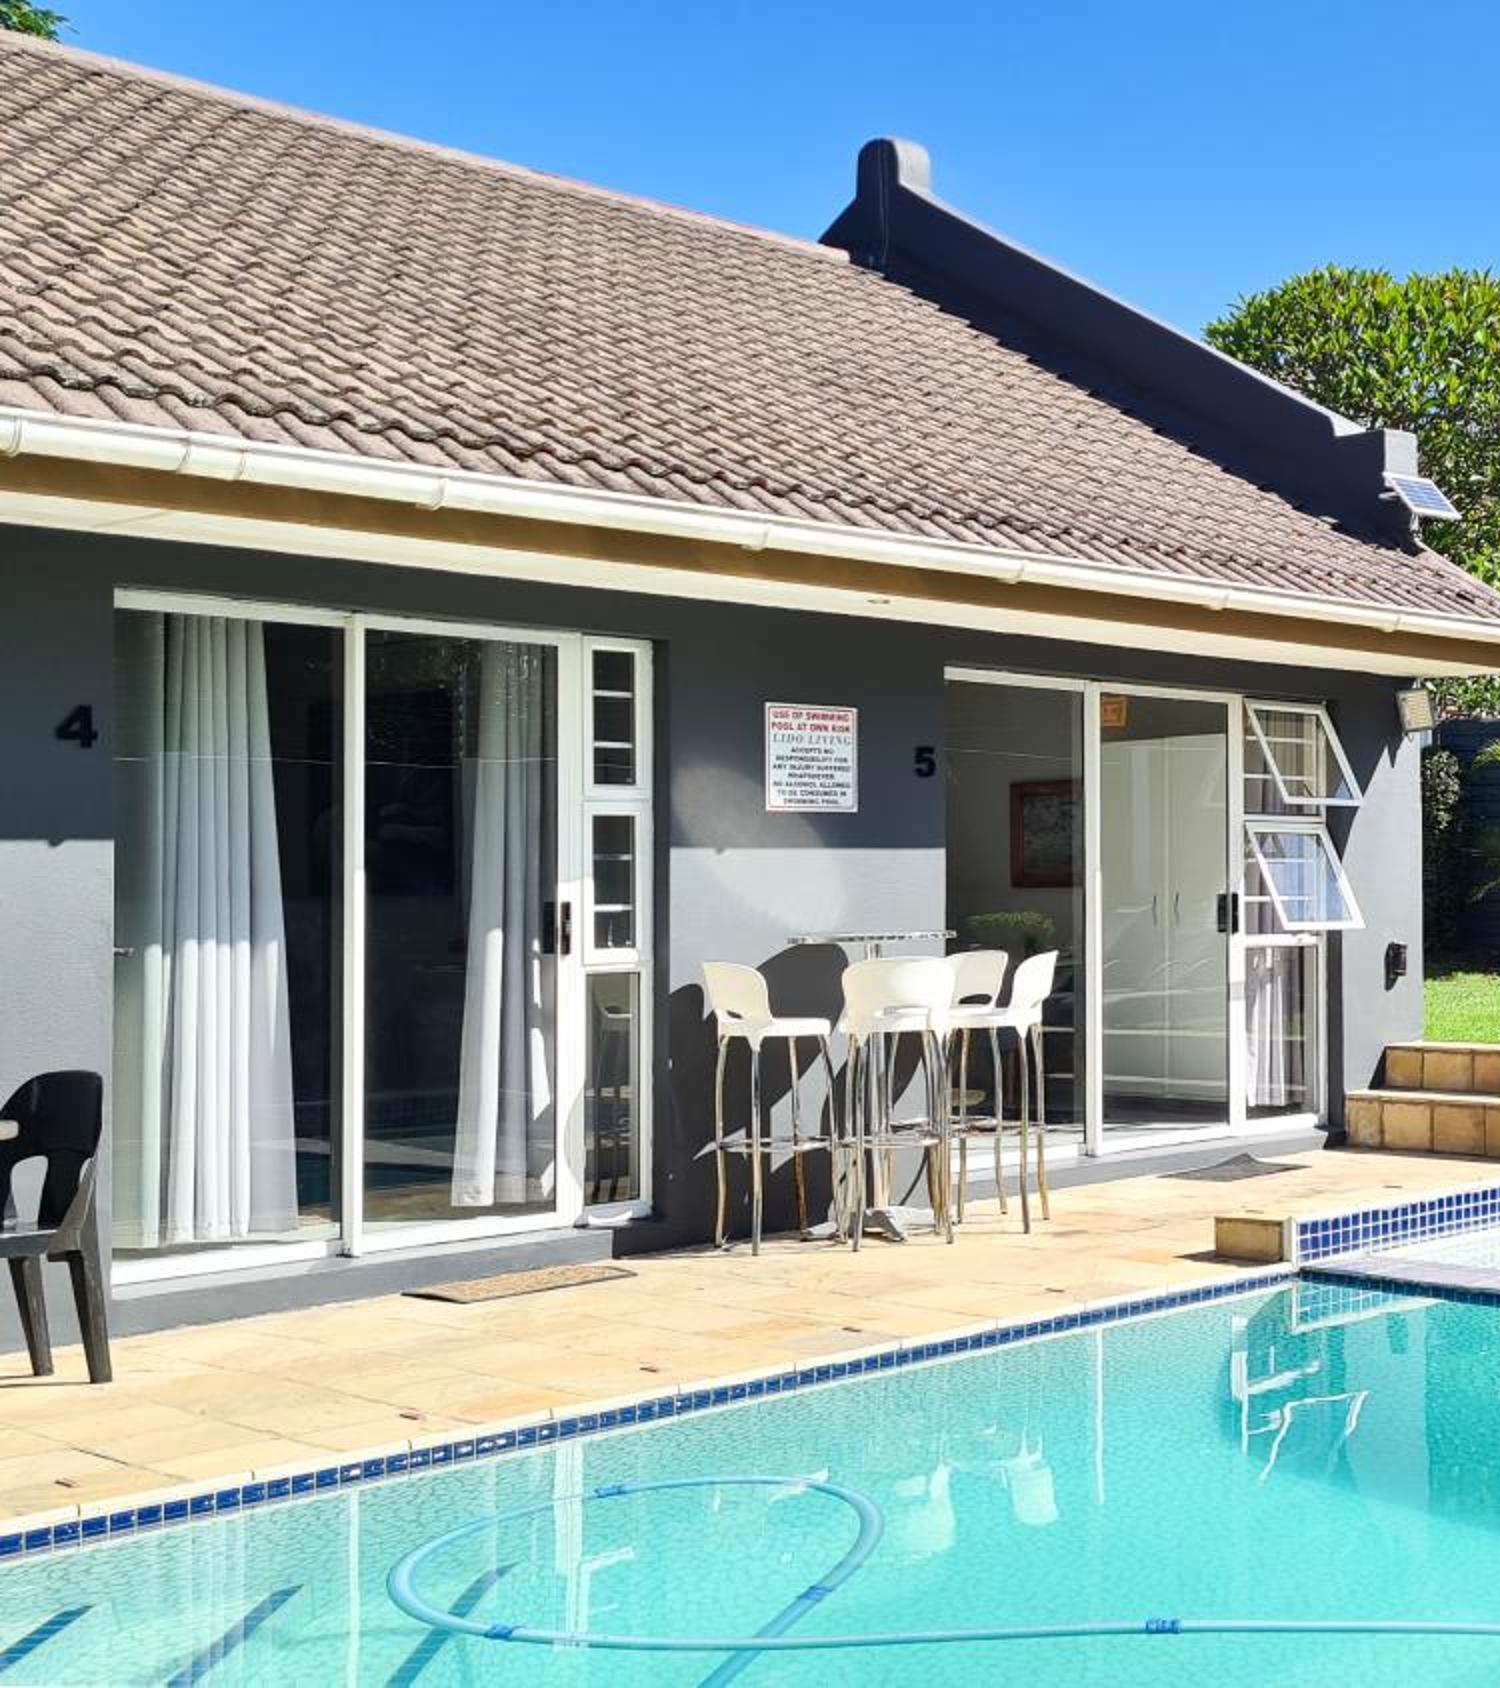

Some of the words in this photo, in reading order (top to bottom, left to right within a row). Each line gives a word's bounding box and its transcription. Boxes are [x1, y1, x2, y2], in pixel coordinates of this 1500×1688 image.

[772, 710, 789, 718] USE
[792, 711, 802, 719] OF
[55, 704, 98, 749] 4
[772, 722, 793, 730] POOL
[798, 723, 807, 731] AT
[810, 724, 829, 732] OWN
[773, 734, 803, 743] LIDO
[809, 735, 850, 744] LIVING
[914, 746, 937, 778] 5
